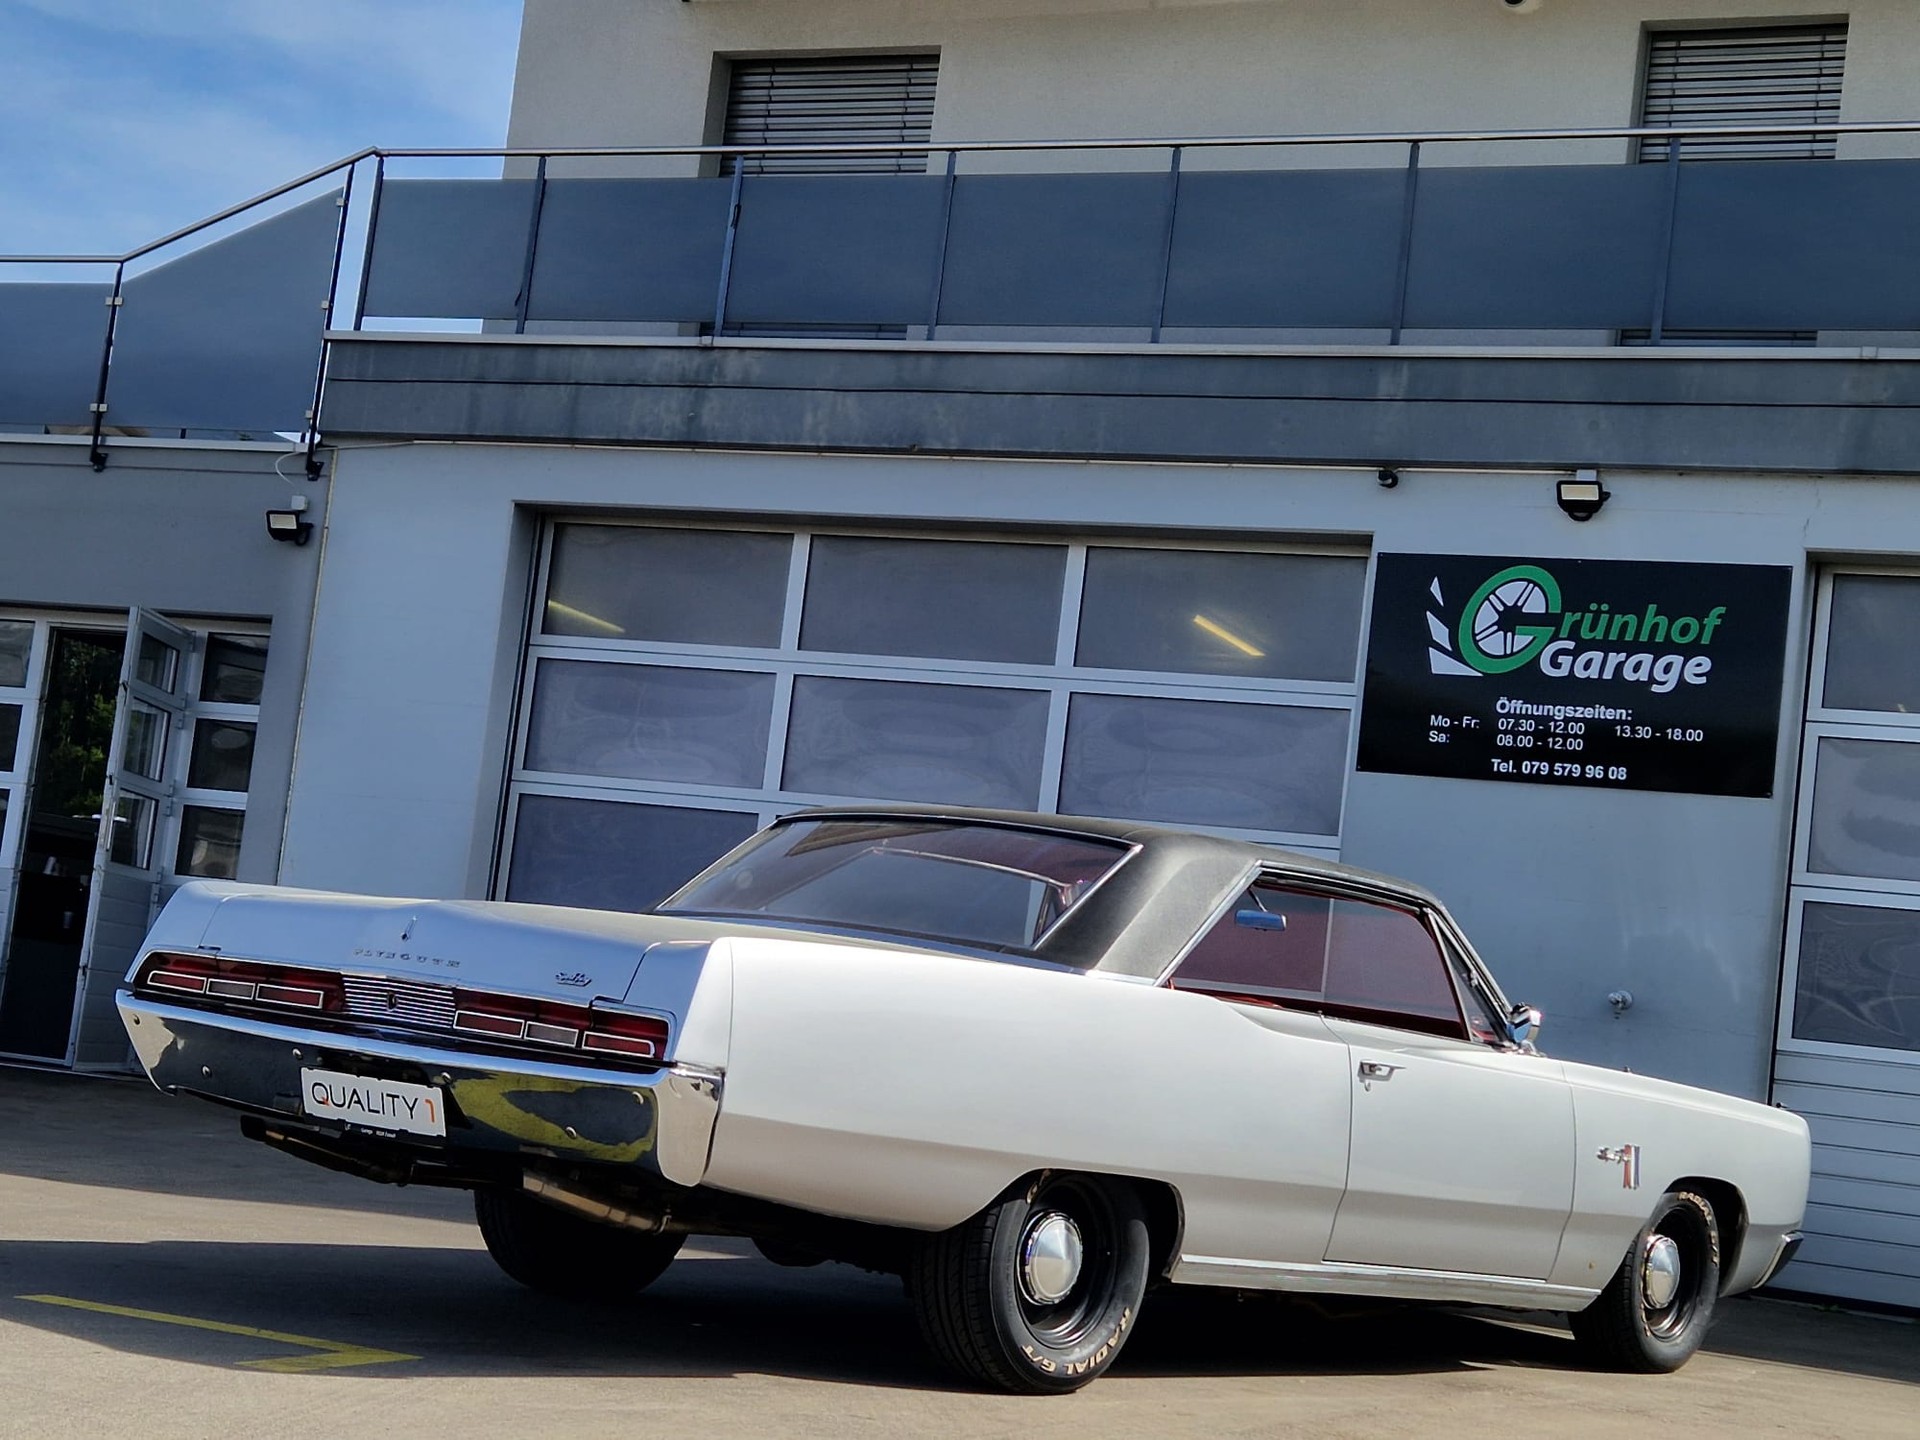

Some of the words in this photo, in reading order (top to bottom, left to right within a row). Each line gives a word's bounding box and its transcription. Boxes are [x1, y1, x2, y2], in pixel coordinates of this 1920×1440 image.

[1458, 564, 1727, 675] Grünhof
[1539, 640, 1713, 693] Garage
[1495, 696, 1633, 721] Öffnungszeiten:
[1428, 730, 1451, 743] Sa:
[1496, 734, 1534, 748] 08.00
[1547, 737, 1584, 751] 12.00
[1430, 714, 1451, 728] Mo
[1498, 718, 1536, 732] 07.30
[1548, 721, 1586, 735] 12.00
[1614, 725, 1652, 739] 13.30
[1665, 728, 1704, 742] 18.00
[1490, 758, 1518, 774] Tel.
[1521, 760, 1550, 776] 079
[1553, 763, 1581, 778] 579
[1585, 764, 1605, 779] 96
[1608, 766, 1628, 780] 08
[1062, 1306, 1132, 1376] RADIAL
[1020, 1343, 1058, 1374] G/T
